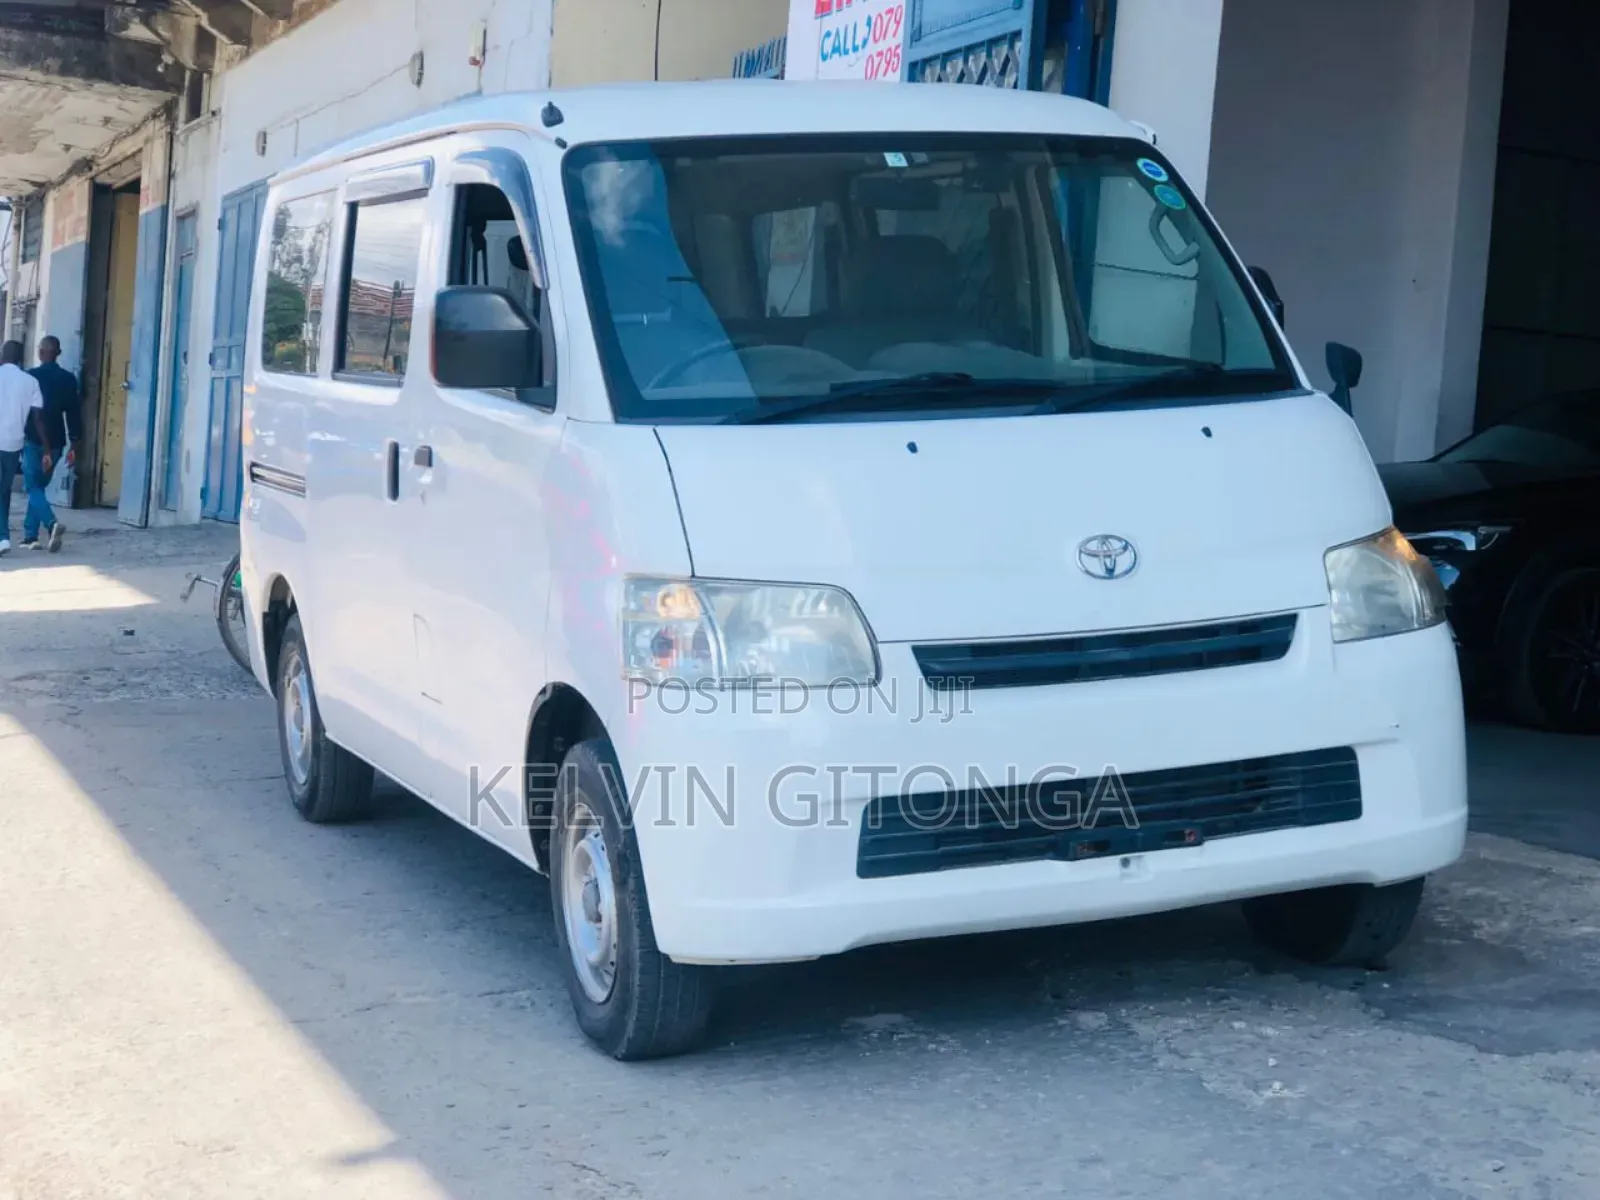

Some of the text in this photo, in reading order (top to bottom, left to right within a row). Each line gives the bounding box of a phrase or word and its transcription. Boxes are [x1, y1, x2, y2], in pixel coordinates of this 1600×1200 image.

[821, 20, 860, 62] CALL
[873, 4, 903, 44] 079
[865, 43, 901, 80] 0795
